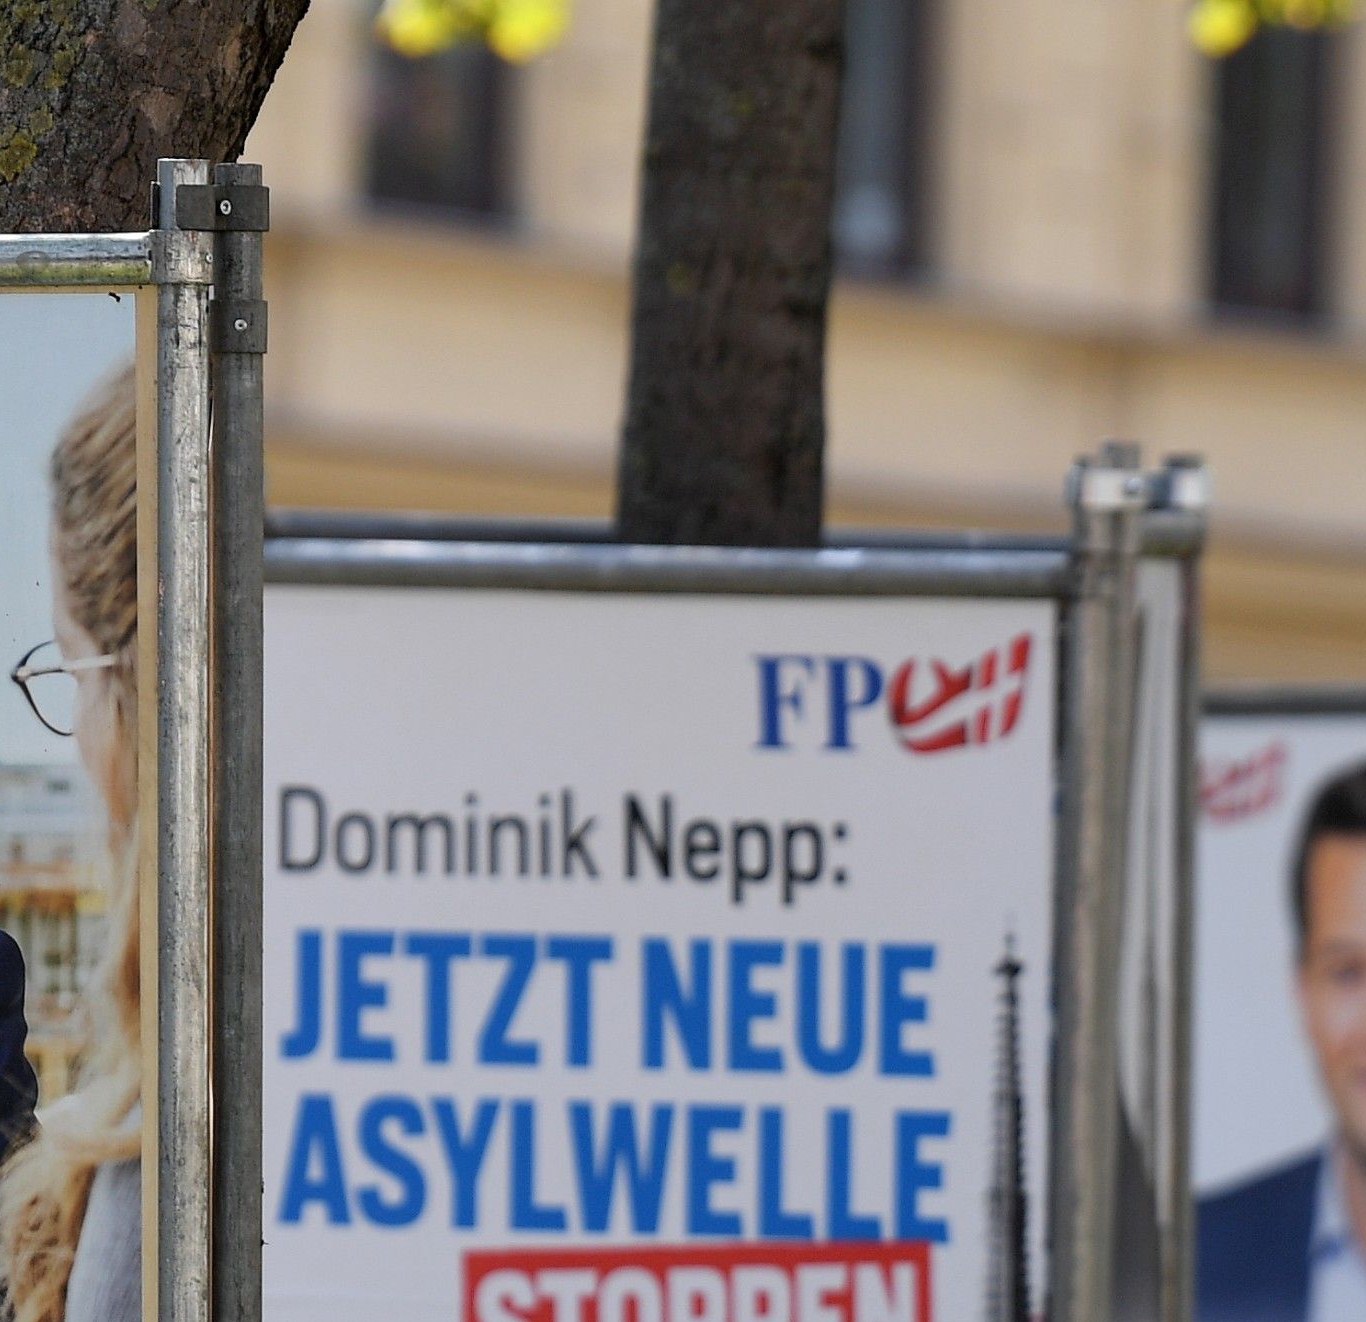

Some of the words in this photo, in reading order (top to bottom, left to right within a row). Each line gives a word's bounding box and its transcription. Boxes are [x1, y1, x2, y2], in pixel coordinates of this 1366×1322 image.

[278, 785, 599, 879] Dominik
[623, 795, 851, 905] Nepp:
[280, 928, 614, 1067] JETZT
[641, 938, 937, 1077] NEUE
[278, 1093, 951, 1244] ASYLWELLE
